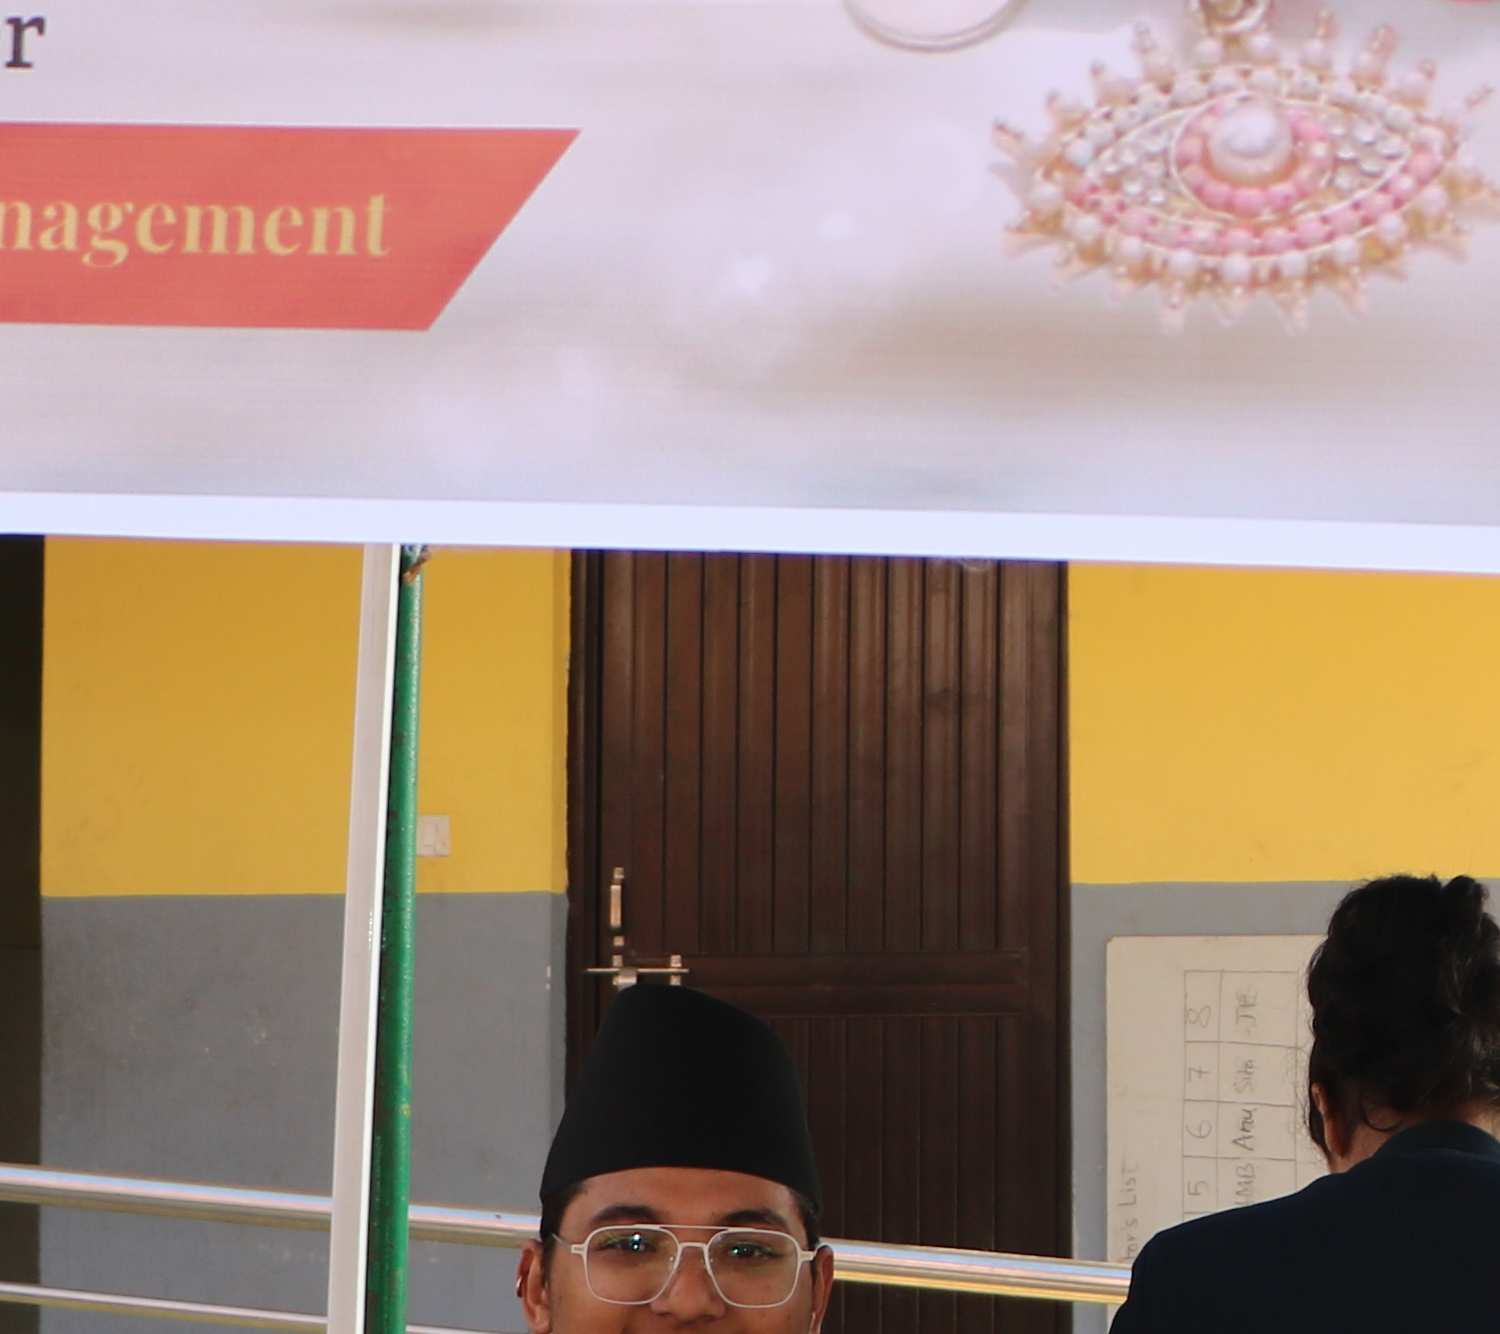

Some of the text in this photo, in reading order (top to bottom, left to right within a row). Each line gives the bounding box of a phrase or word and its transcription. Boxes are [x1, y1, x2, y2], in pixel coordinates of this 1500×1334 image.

[1187, 1004, 1212, 1197] 5 6 7 8
